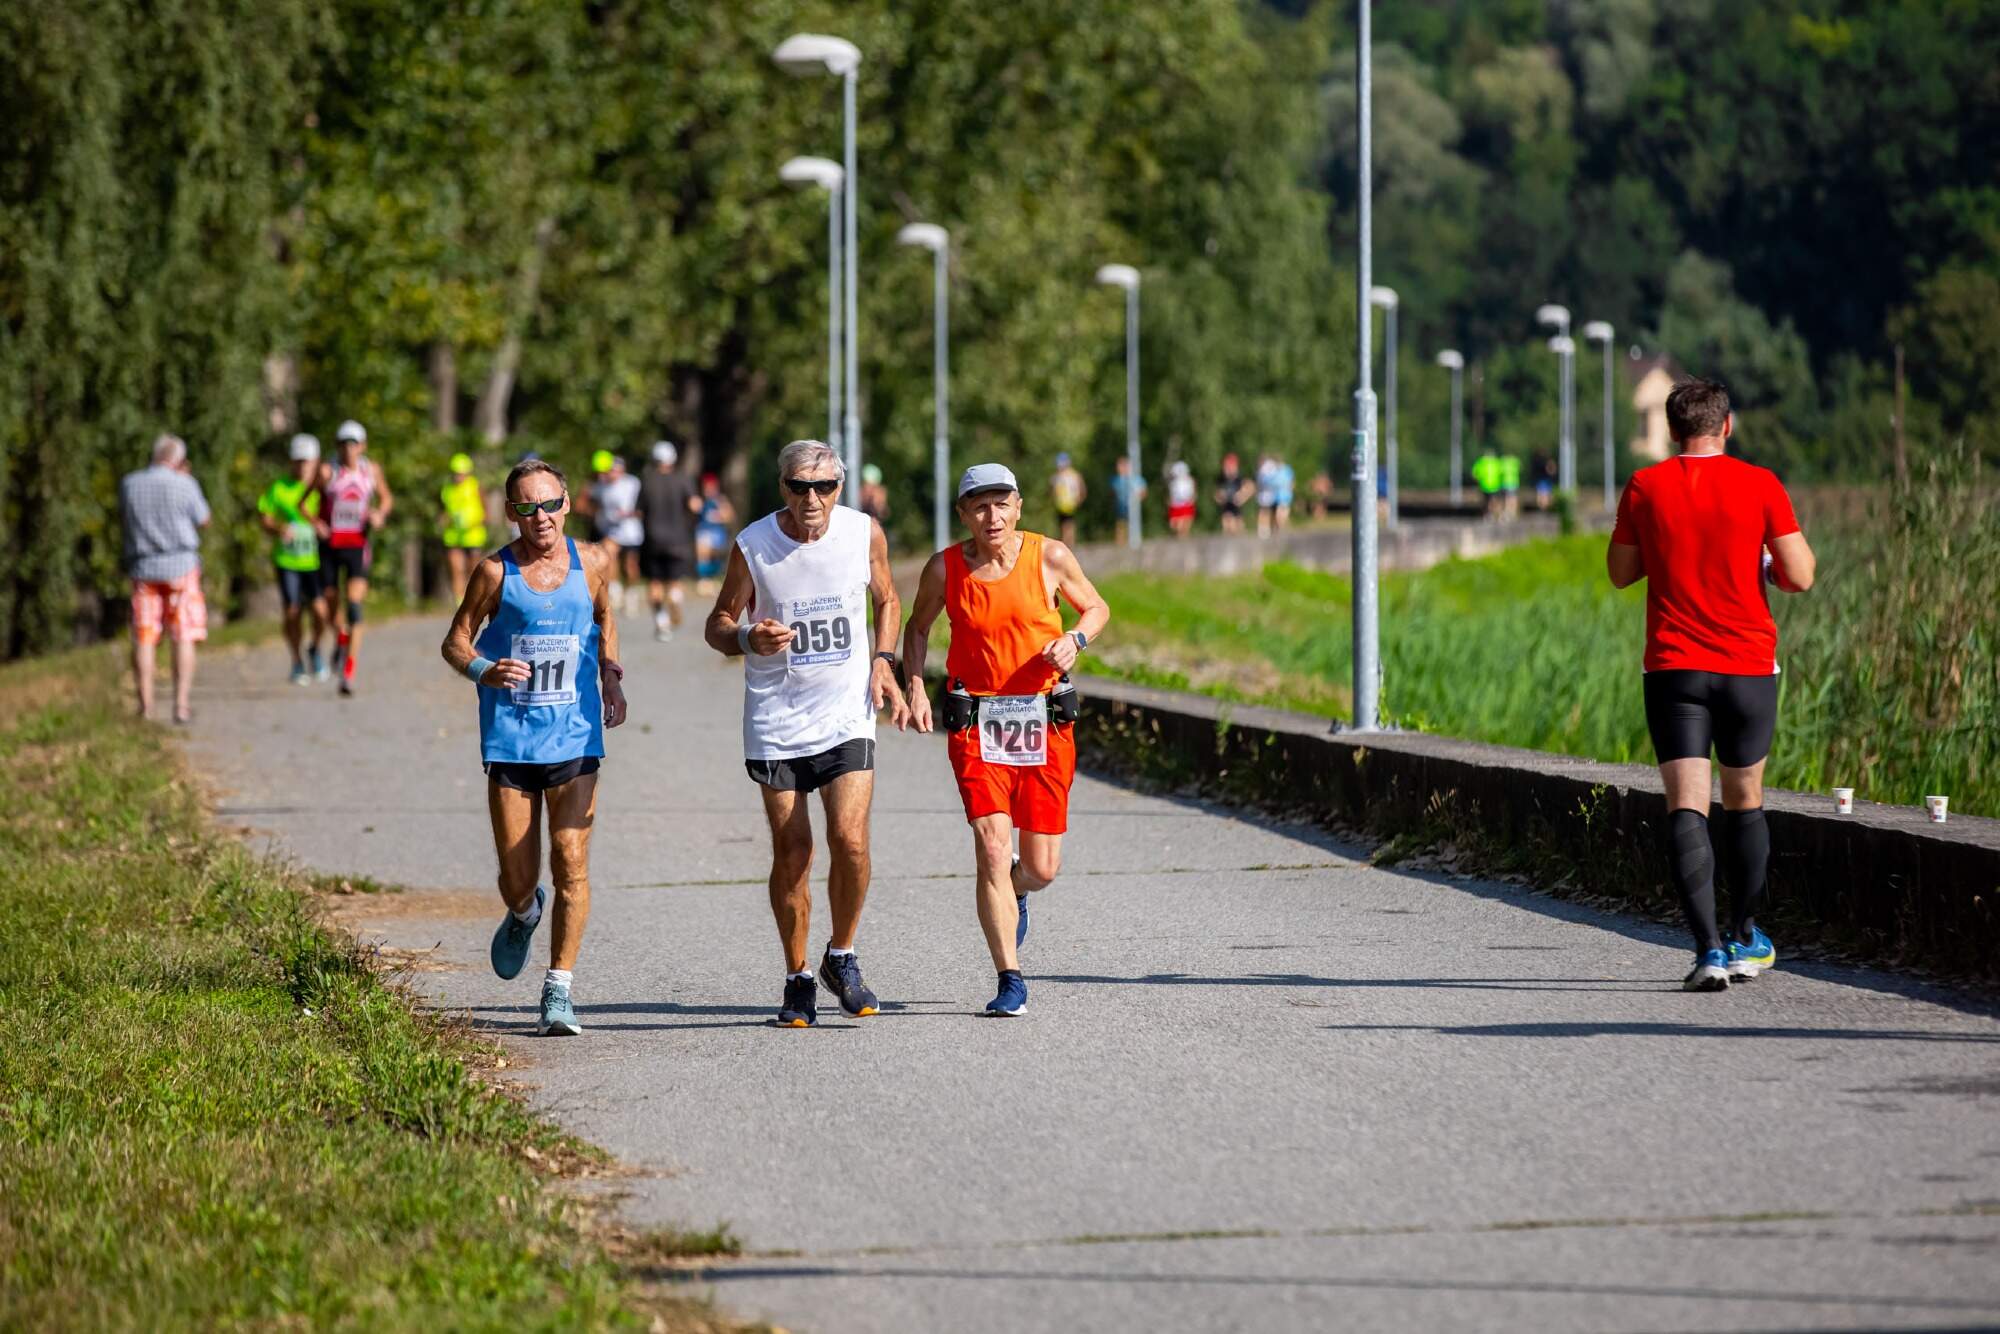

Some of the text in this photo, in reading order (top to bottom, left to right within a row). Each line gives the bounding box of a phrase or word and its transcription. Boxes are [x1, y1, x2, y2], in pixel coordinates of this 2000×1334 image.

[789, 616, 852, 654] 059
[528, 659, 566, 691] 111
[984, 720, 1041, 752] 026
